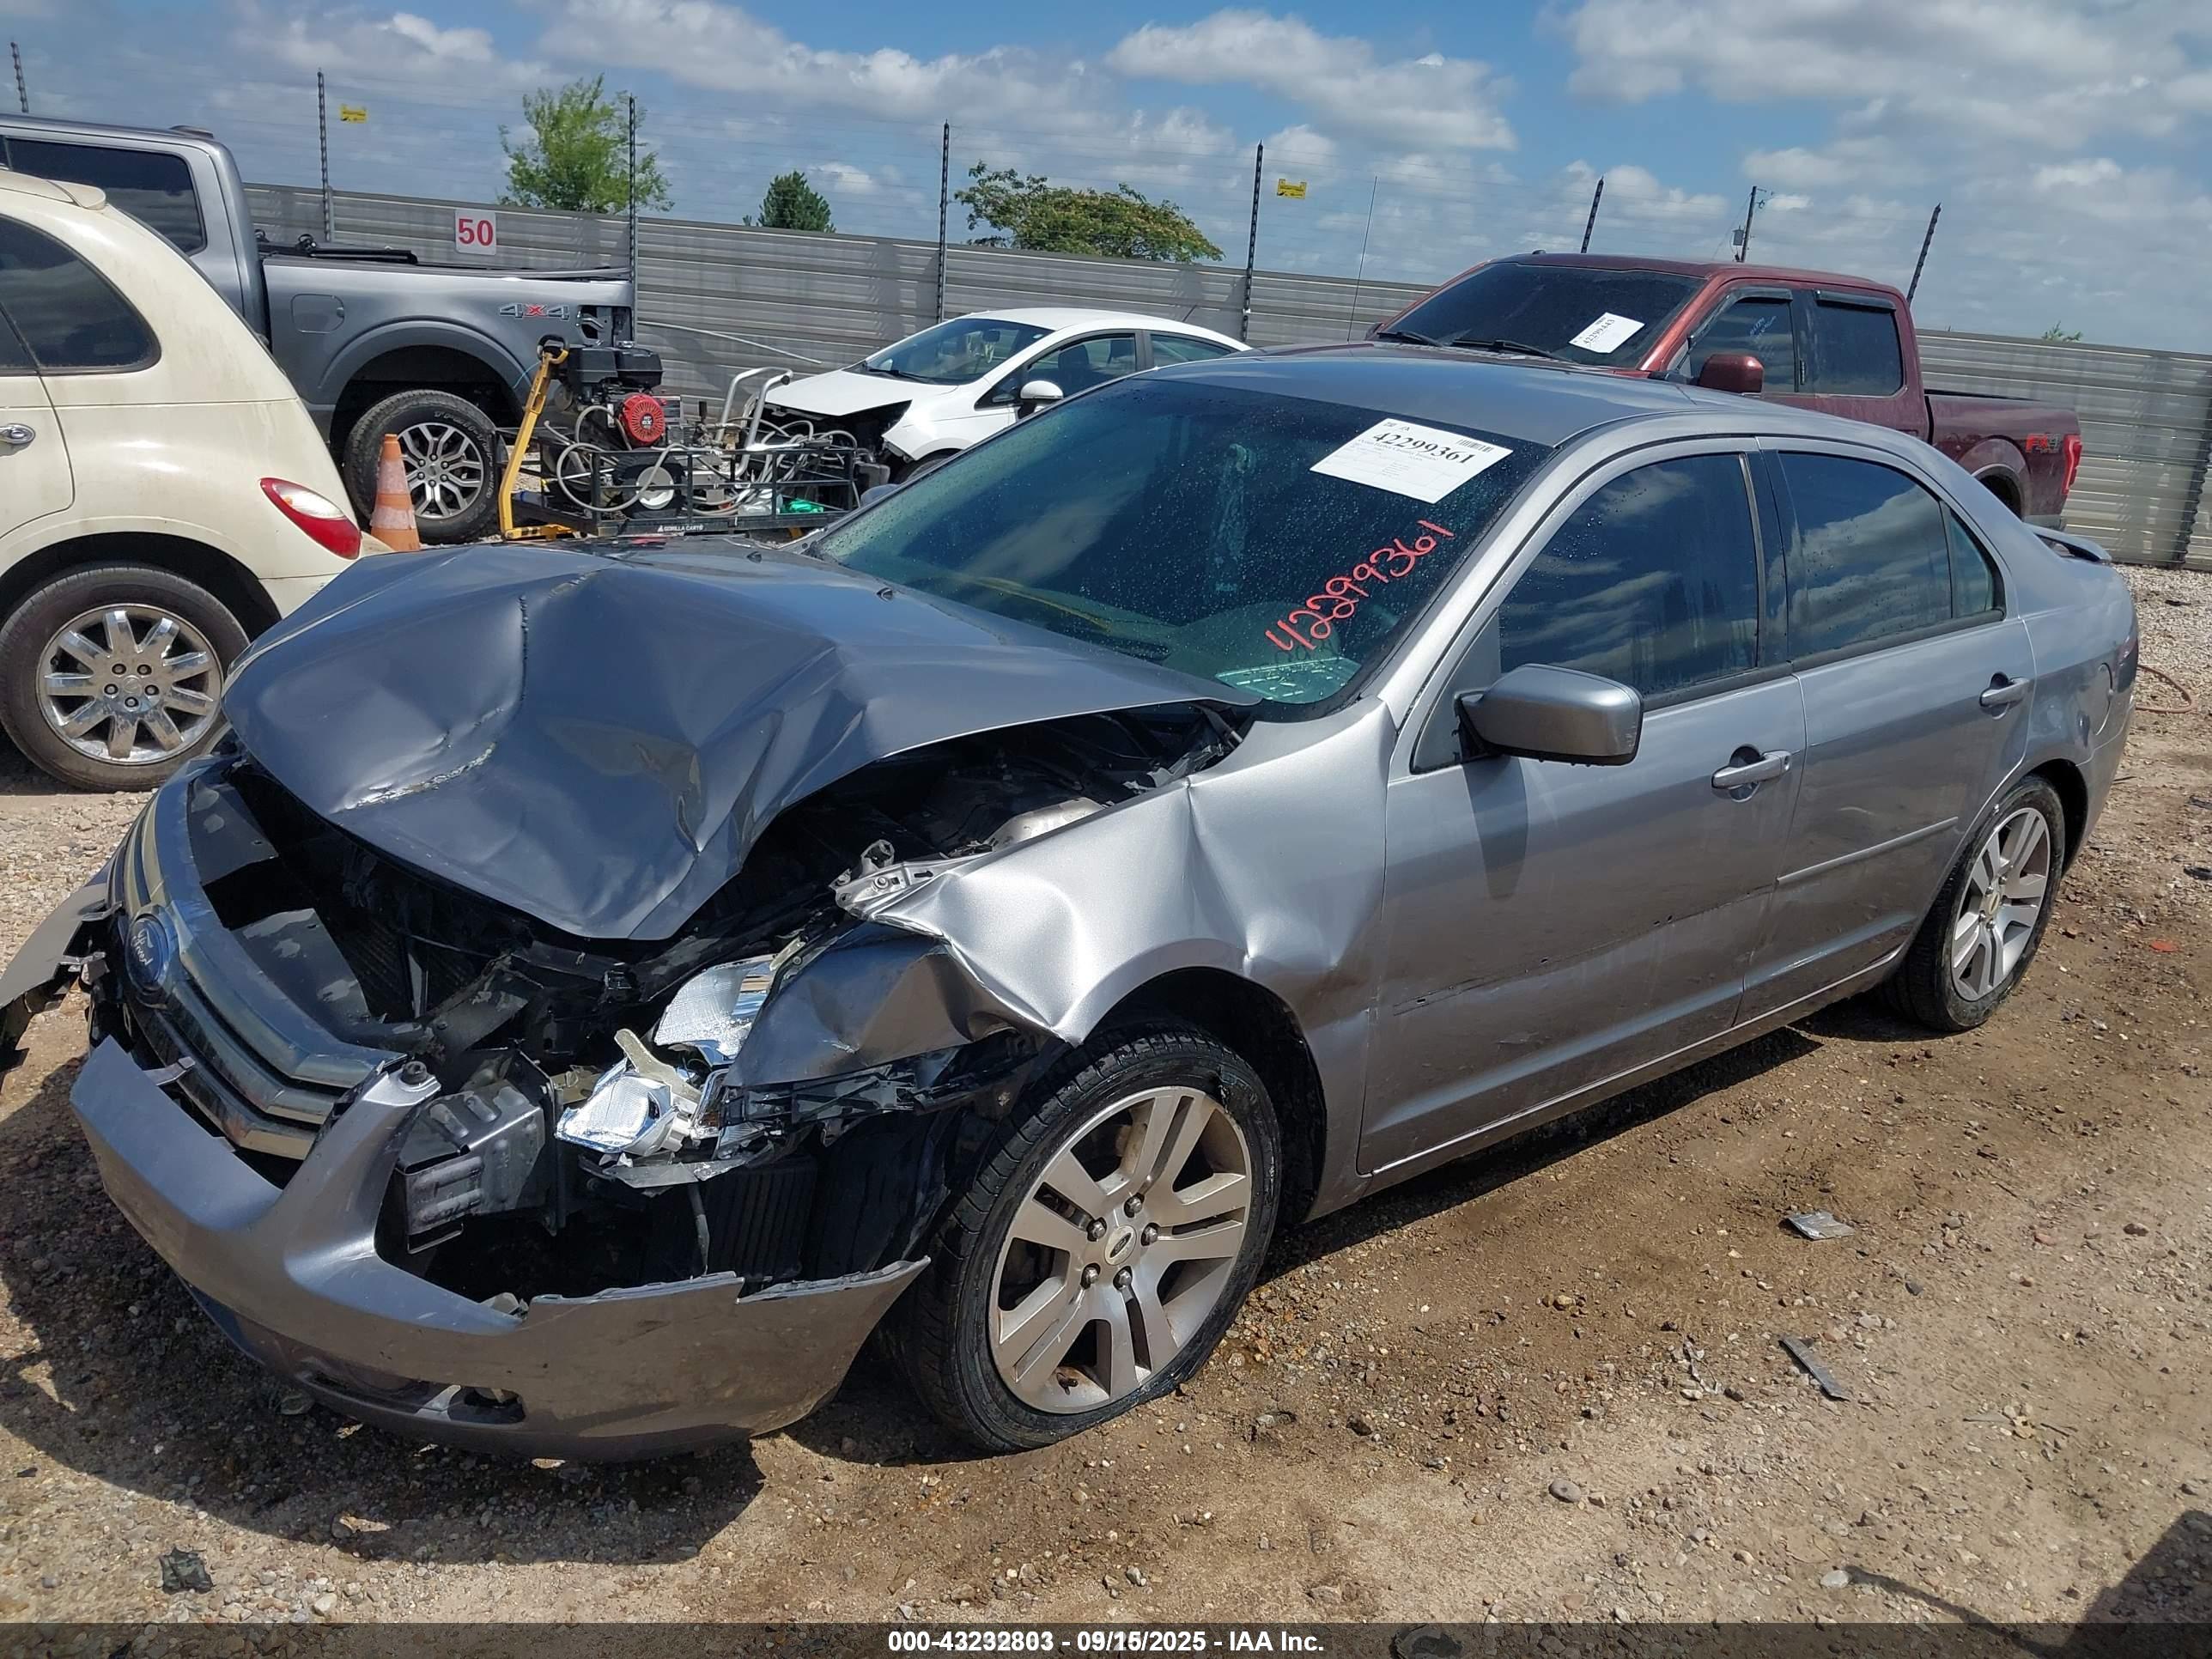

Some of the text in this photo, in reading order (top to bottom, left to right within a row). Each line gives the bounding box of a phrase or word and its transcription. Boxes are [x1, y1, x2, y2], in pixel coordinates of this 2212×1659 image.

[459, 218, 494, 246] 50
[1373, 432, 1476, 465] 42299361
[1265, 519, 1455, 651] 42299361
[130, 927, 155, 966] Ford
